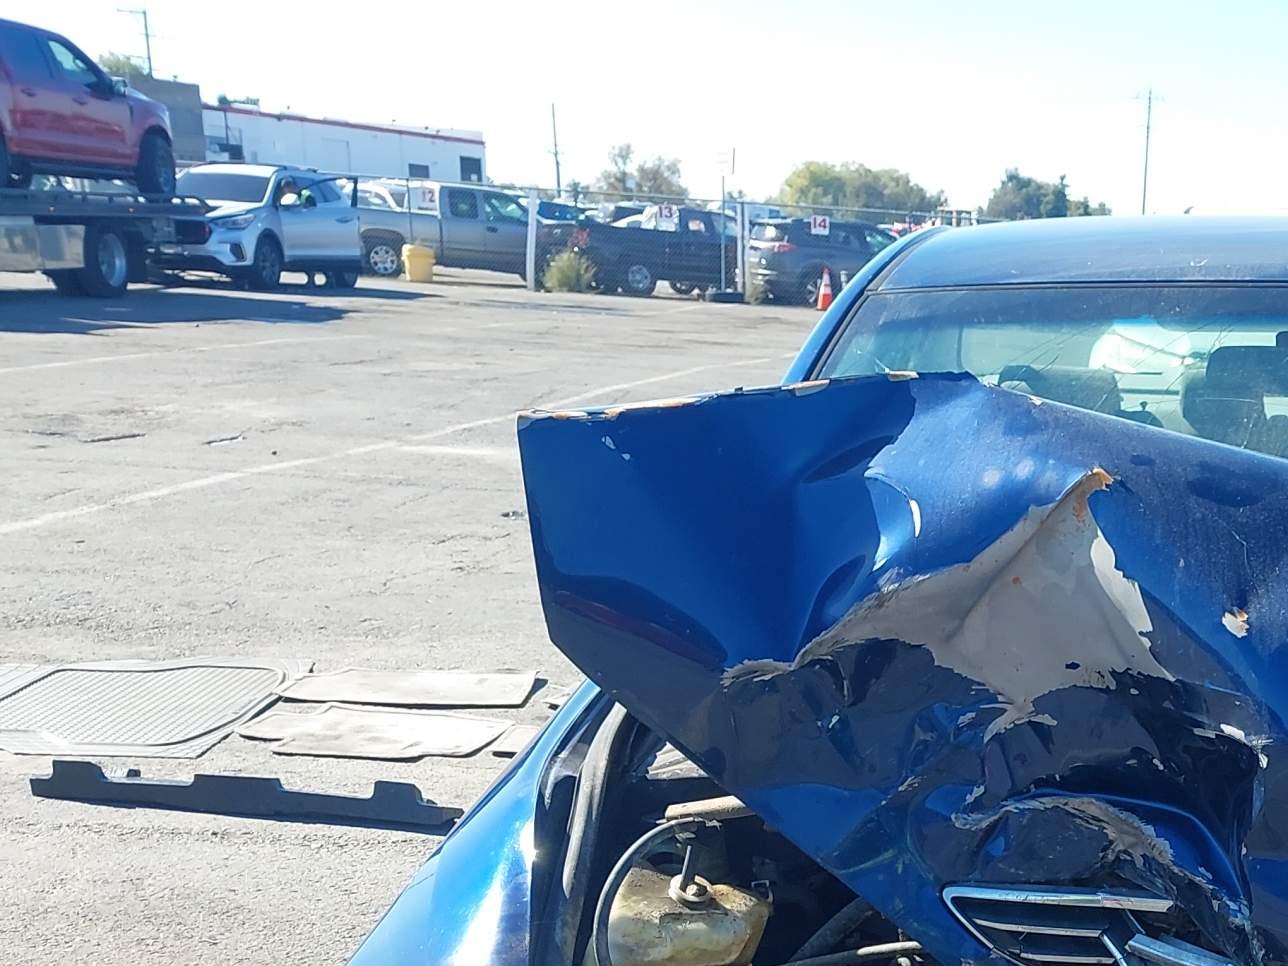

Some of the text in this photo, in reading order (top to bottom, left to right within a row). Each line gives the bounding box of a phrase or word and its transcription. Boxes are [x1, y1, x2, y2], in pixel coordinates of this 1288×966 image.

[422, 191, 435, 203] 12
[658, 204, 673, 218] 13
[812, 216, 828, 230] 14
